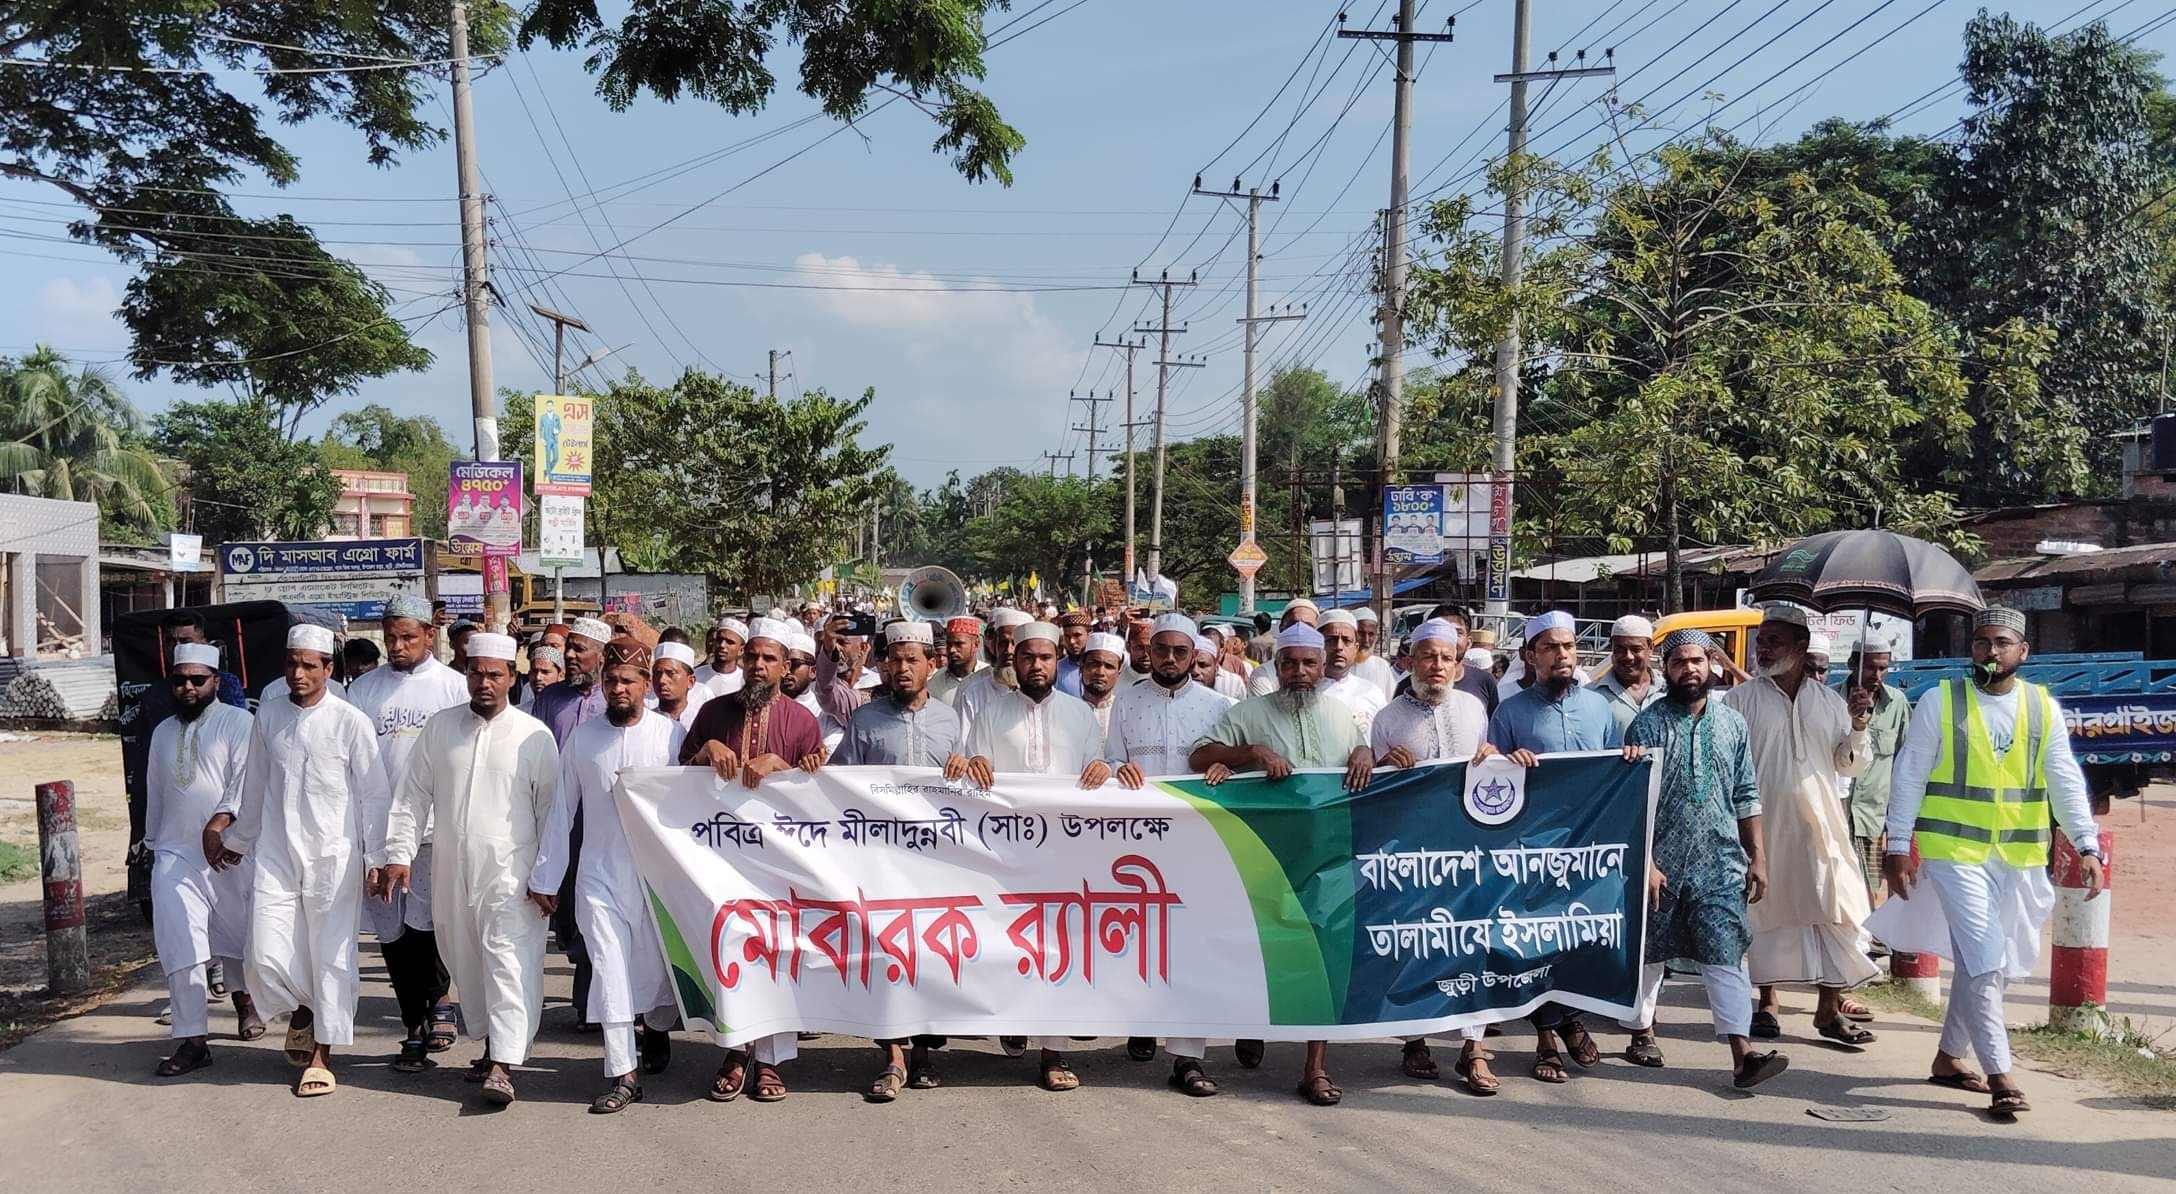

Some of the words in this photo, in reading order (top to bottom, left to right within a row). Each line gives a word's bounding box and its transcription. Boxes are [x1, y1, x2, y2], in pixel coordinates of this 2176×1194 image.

[456, 463, 515, 479] মেডিকেল
[1390, 487, 1415, 502] ঢাবি
[256, 545, 275, 566] দি
[279, 548, 338, 564] মাসআব
[342, 546, 379, 564] এগ্রো
[383, 541, 417, 562] ফার্ম
[1830, 610, 1857, 626] ফিড
[691, 811, 764, 849] পবিত্র
[838, 807, 968, 850] মীলাদুন্নবী
[1059, 812, 1174, 844] উপলক্ষে
[1356, 844, 1485, 892] বাংলাদেশ
[1489, 841, 1630, 891] আনজুমানে
[710, 886, 985, 991] মোবারক
[1498, 902, 1624, 959] ইসলামিয়া
[1435, 972, 1479, 998] জুড়ী
[1481, 965, 1553, 989] উপজেলা
